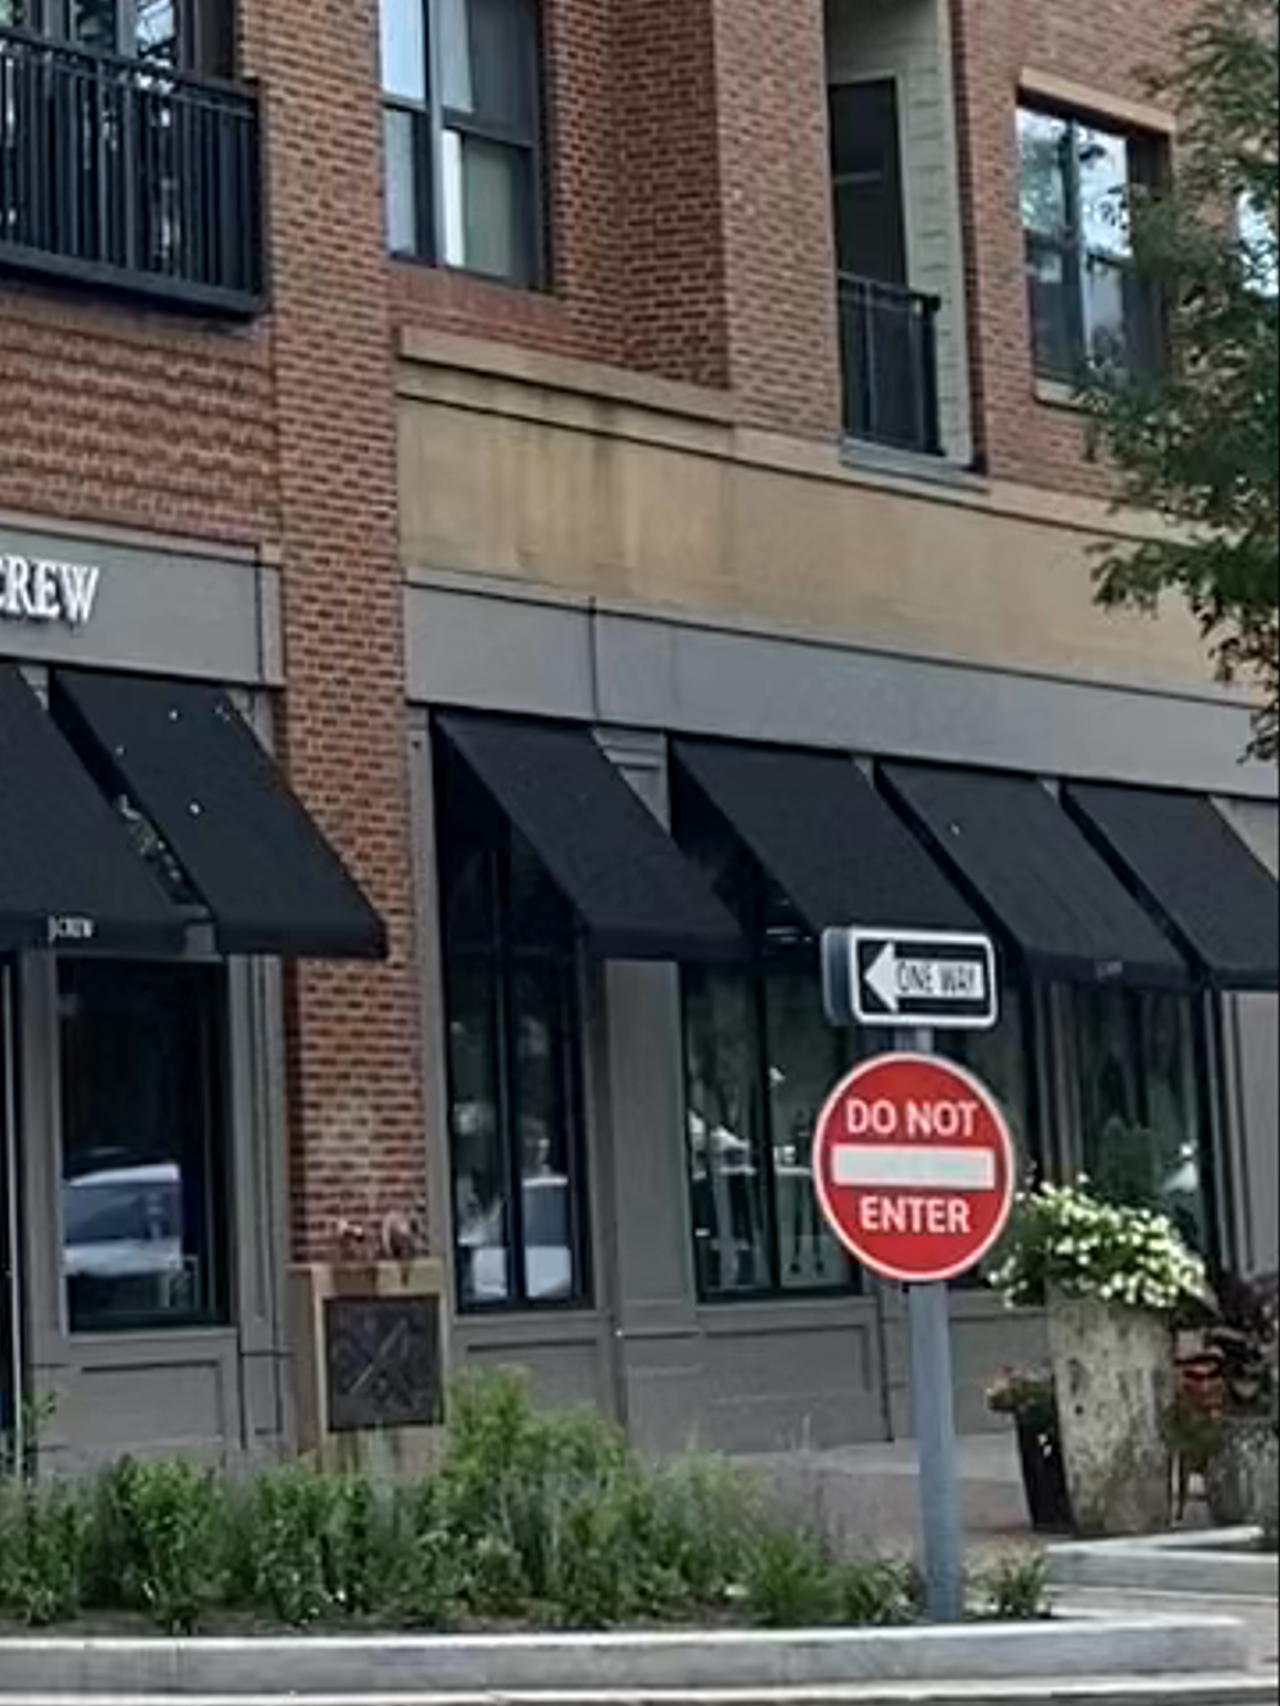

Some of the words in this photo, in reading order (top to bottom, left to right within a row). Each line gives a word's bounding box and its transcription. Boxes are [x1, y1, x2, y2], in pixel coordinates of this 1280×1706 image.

[897, 959, 935, 993] ONE
[940, 963, 976, 993] WAY
[845, 1097, 897, 1135] DO
[905, 1098, 979, 1137] NOT
[859, 1194, 972, 1235] ENTER
